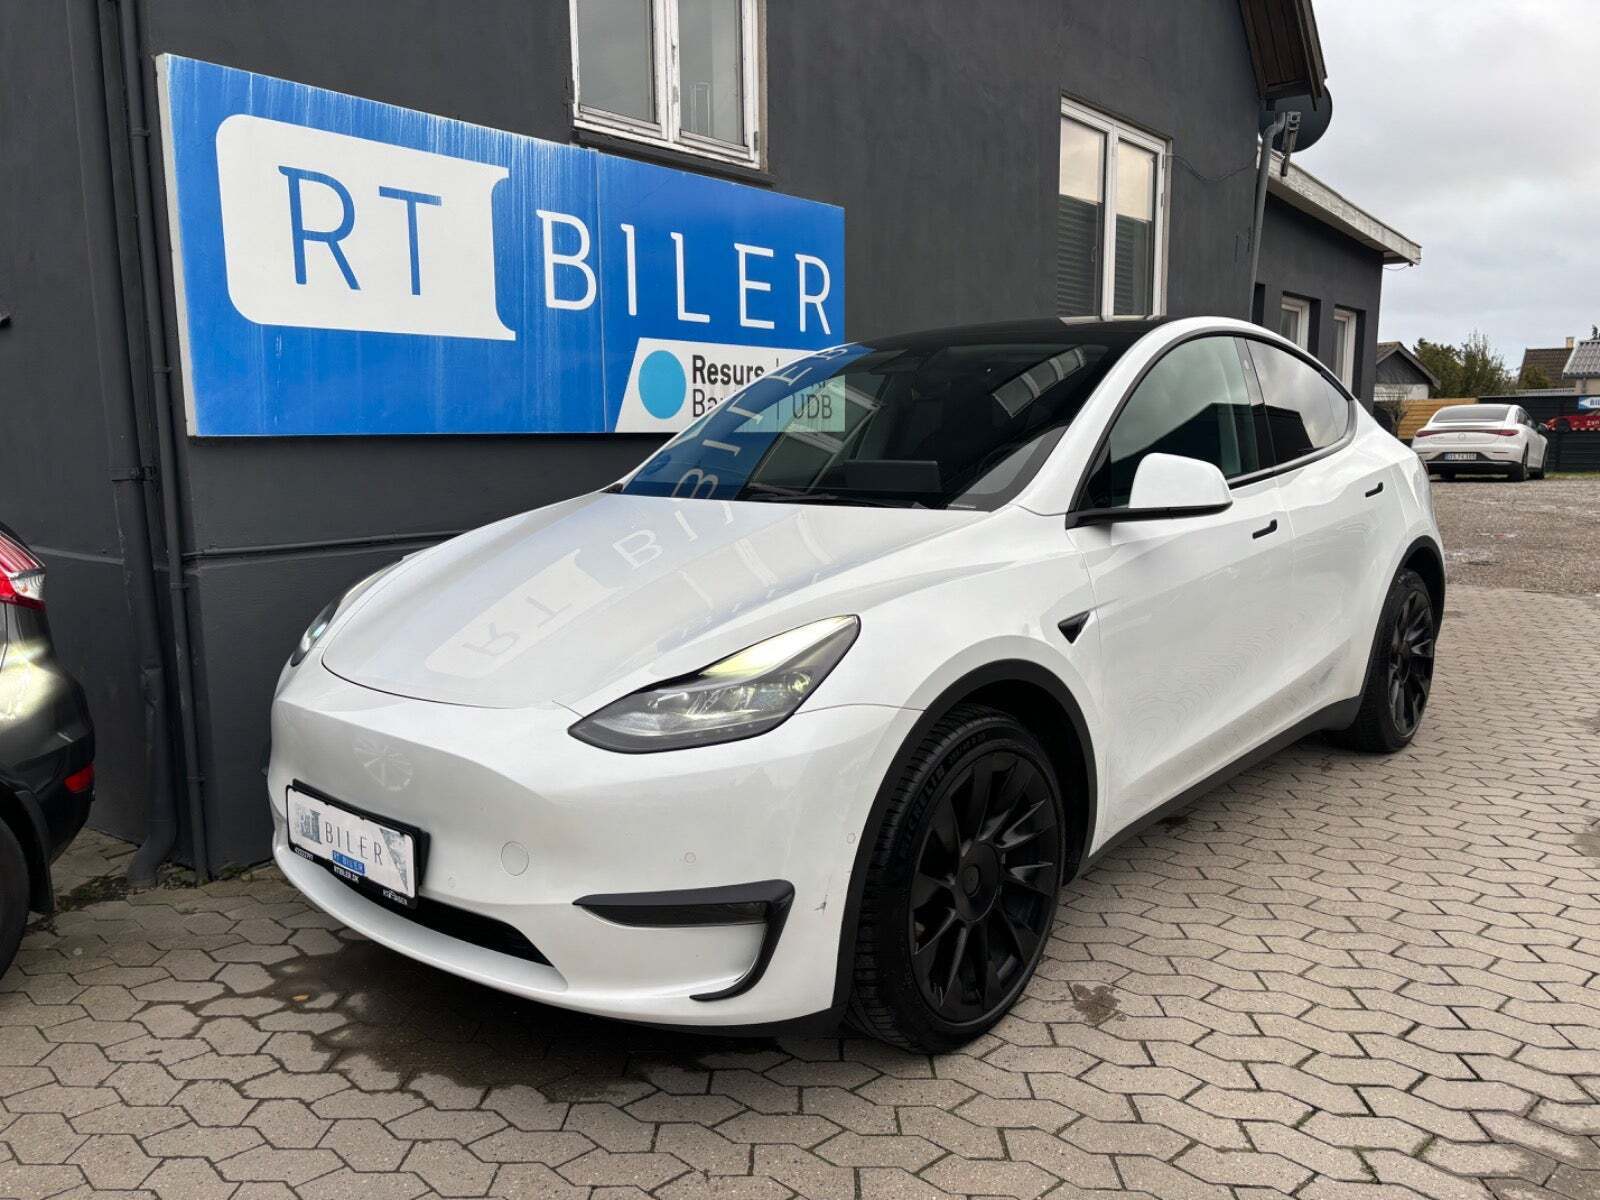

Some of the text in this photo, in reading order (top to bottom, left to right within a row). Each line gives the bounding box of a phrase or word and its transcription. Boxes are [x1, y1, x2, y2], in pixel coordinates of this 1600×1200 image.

[278, 165, 832, 336] RT BILER
[692, 354, 766, 386] Resurs
[792, 394, 833, 421] UDB
[325, 821, 383, 866] BILER
